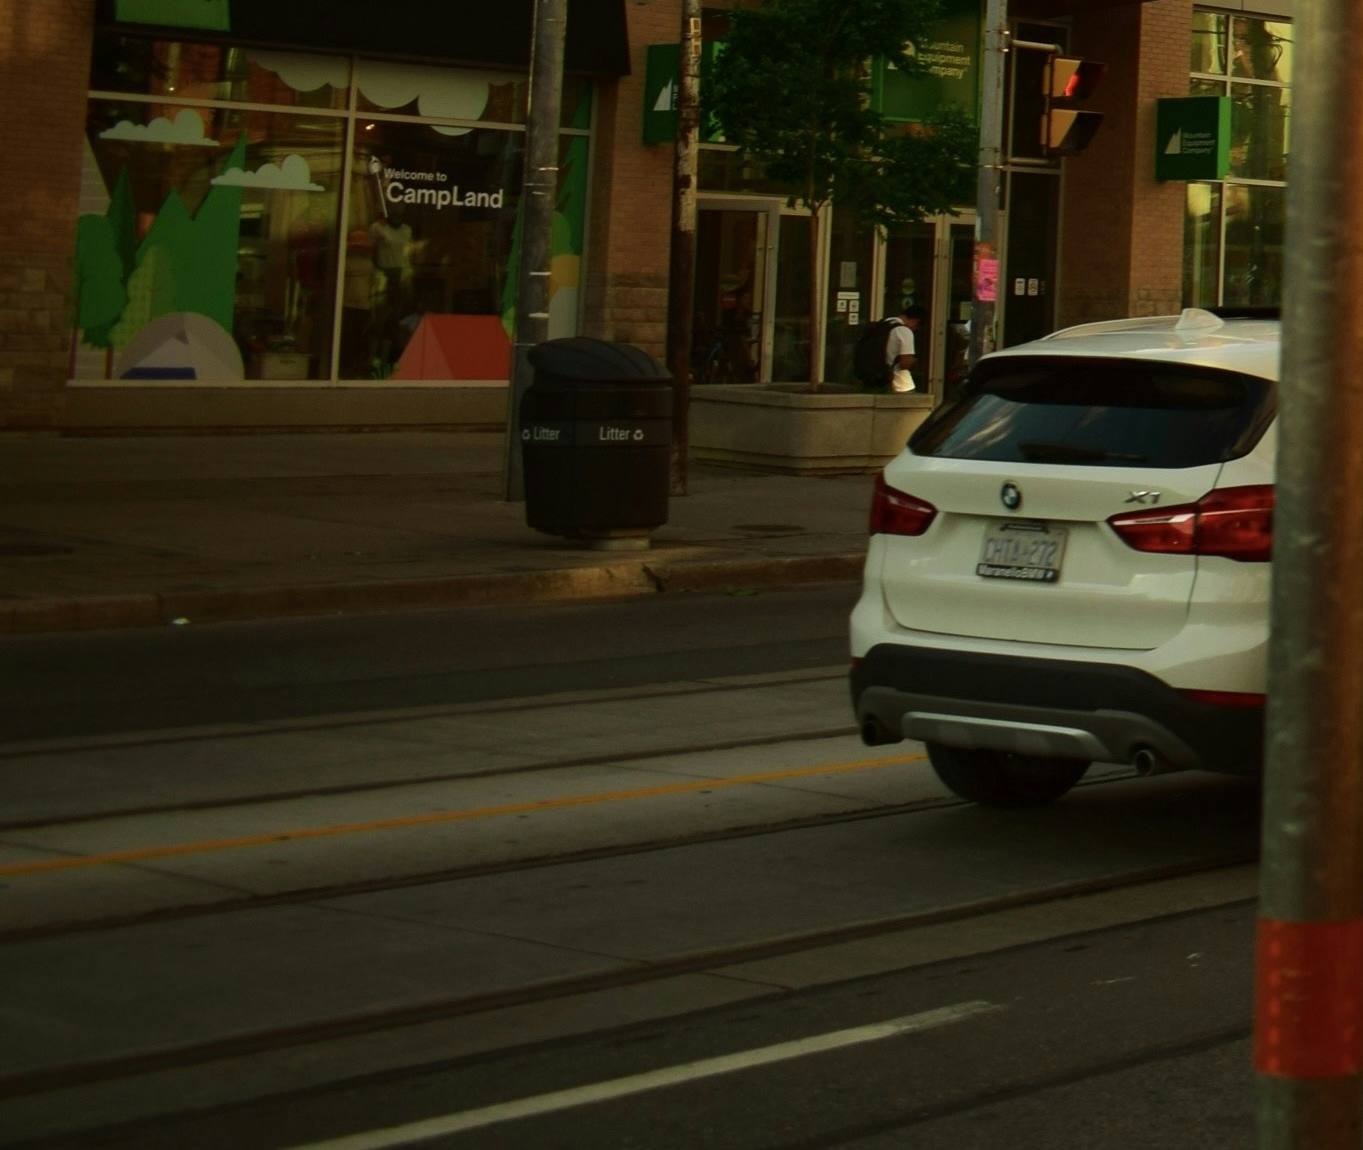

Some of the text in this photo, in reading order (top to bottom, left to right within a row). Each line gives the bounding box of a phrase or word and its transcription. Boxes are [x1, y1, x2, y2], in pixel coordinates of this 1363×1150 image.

[384, 168, 448, 182] Welcome to
[386, 181, 504, 210] CampLand
[533, 426, 560, 440] Litter
[600, 426, 630, 441] Litter
[1124, 490, 1161, 504] X1
